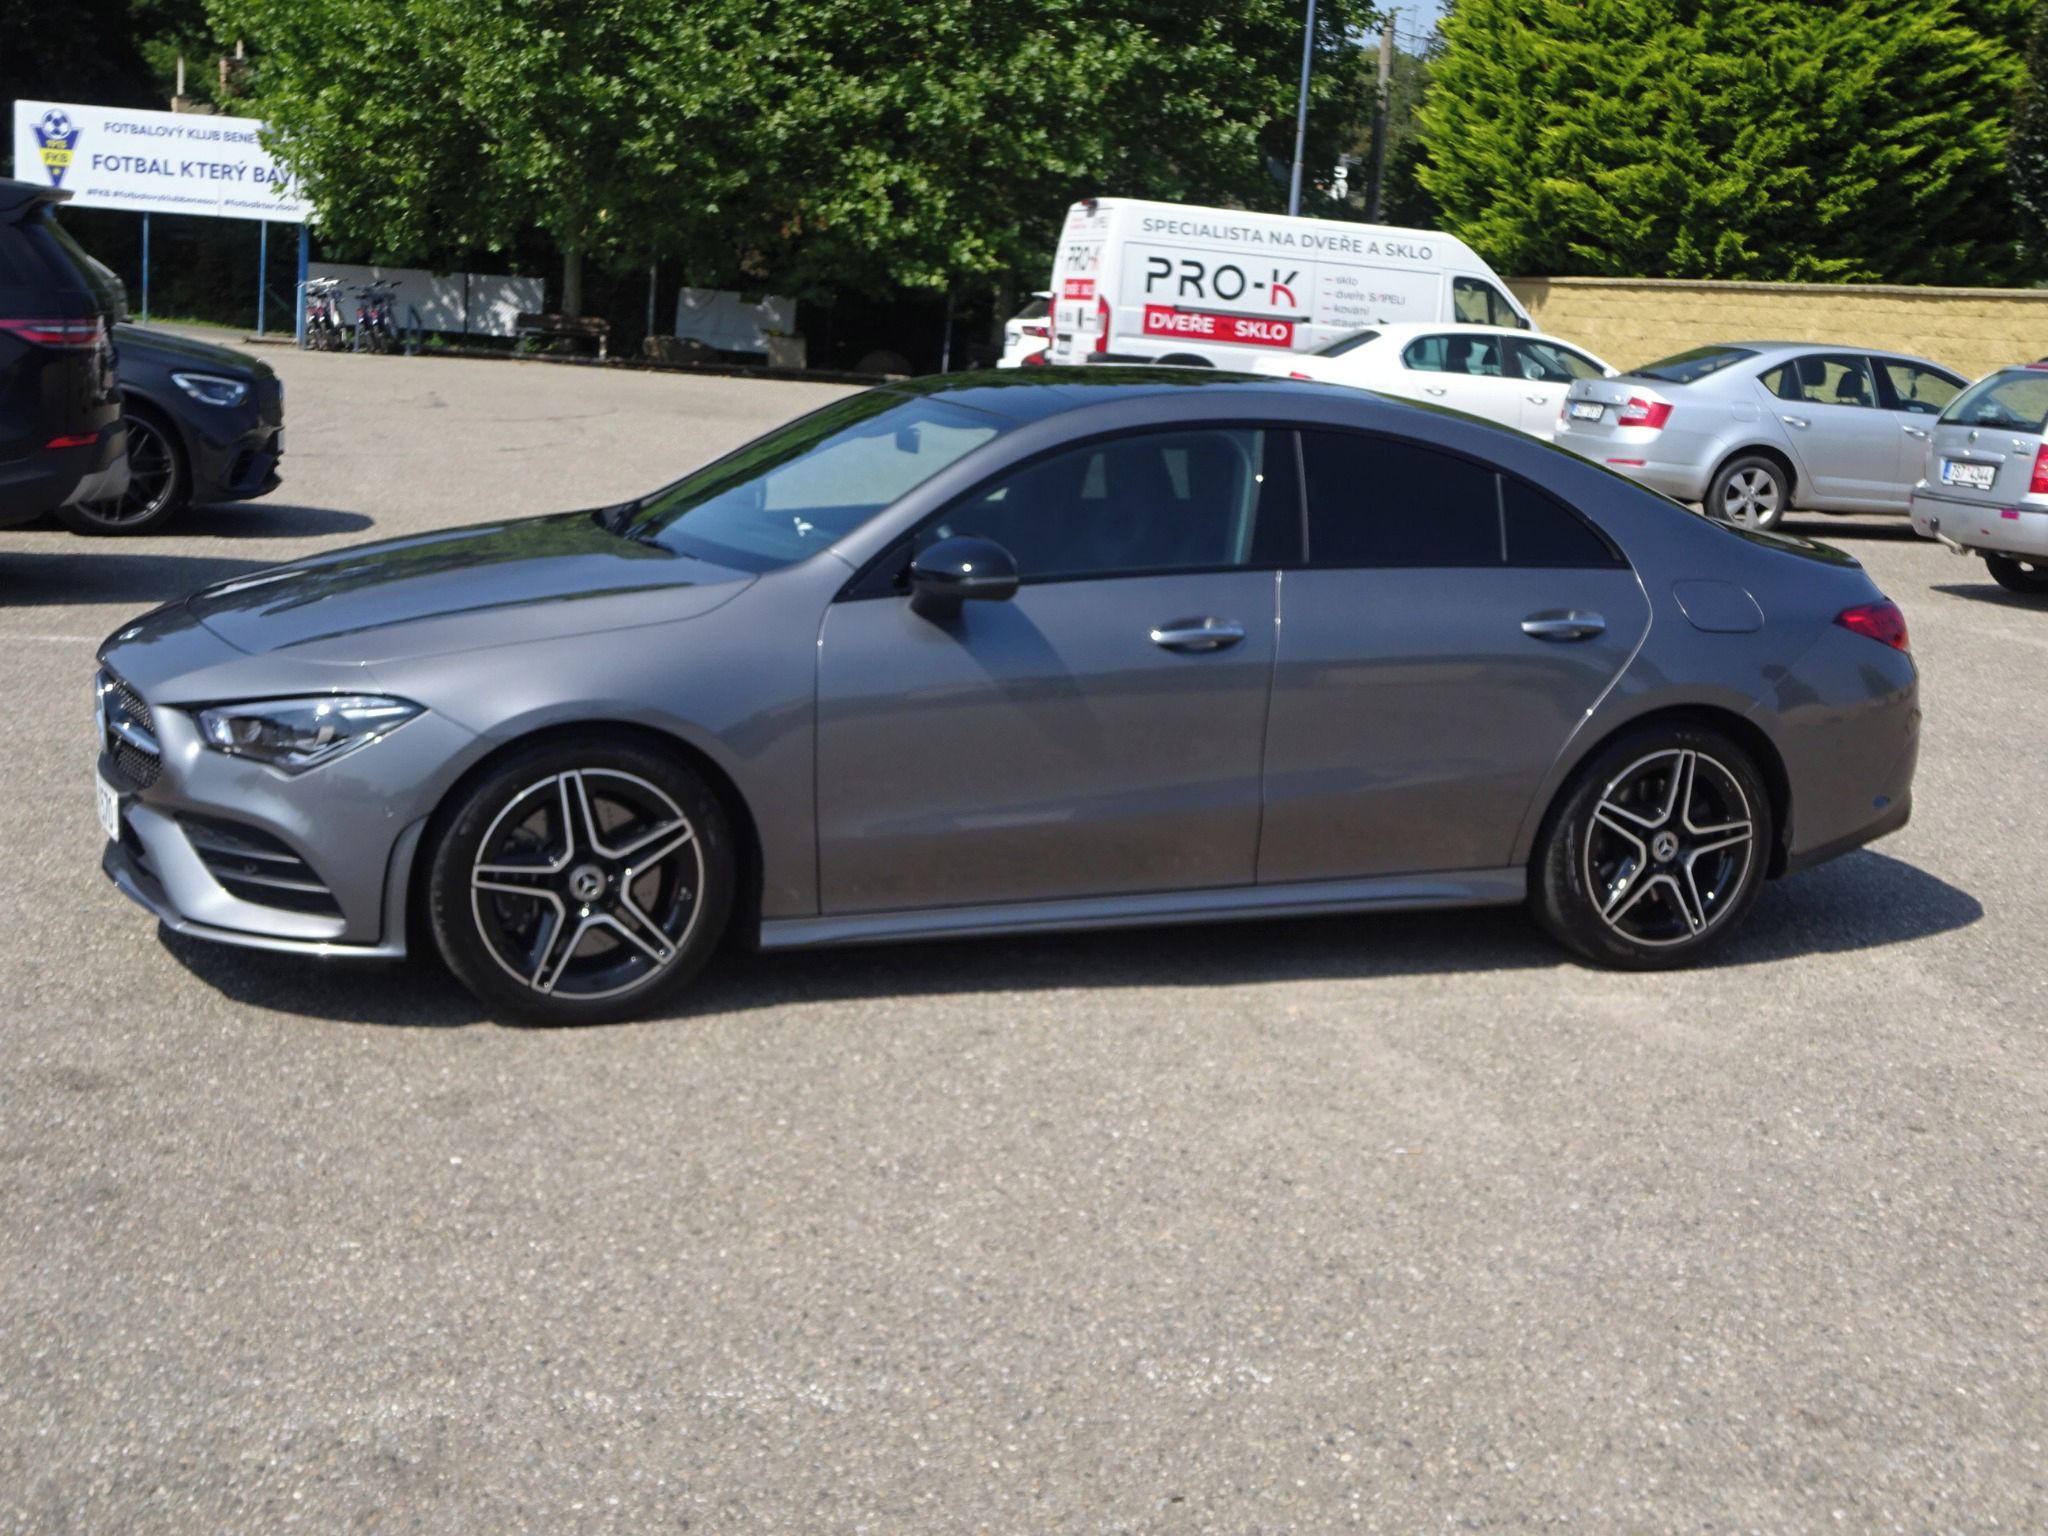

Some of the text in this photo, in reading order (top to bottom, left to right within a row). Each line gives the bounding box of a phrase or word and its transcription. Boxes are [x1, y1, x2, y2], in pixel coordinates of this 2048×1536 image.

[104, 122, 184, 138] FOTBALOVÝ
[186, 128, 221, 141] KLUB
[92, 154, 175, 176] FOTBAL
[180, 160, 248, 182] KTERÝ
[1143, 218, 1433, 260] SPECIALISTA NA DVEŘE A SKLO
[1145, 256, 1299, 308] PRO-K
[1335, 276, 1358, 286] sklo
[1149, 312, 1288, 340] DVEŘE SKLO
